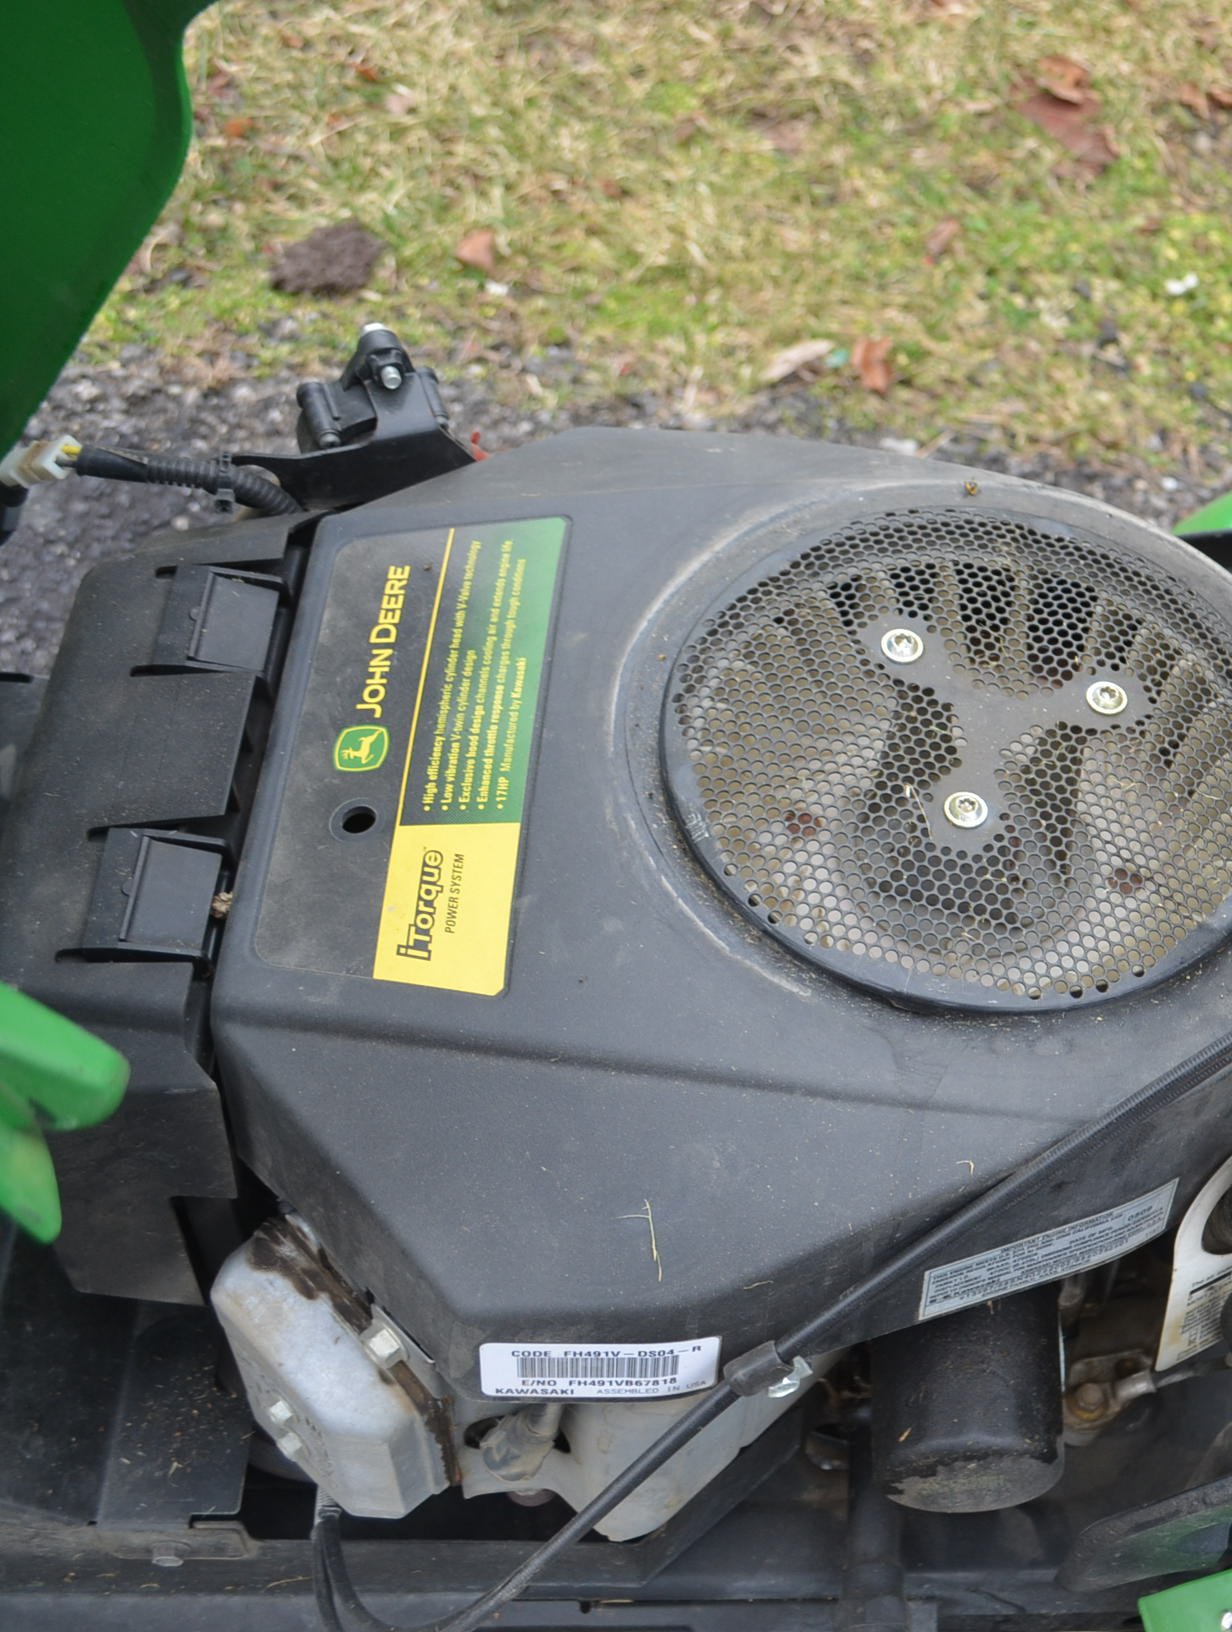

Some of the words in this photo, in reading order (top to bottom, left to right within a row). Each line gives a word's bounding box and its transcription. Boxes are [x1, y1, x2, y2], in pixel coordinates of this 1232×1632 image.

[464, 541, 480, 579] technology
[499, 553, 510, 576] engine
[493, 578, 505, 606] extends
[512, 559, 525, 595] conditions
[369, 565, 410, 643] DEERE
[455, 610, 465, 626] with
[490, 608, 500, 622] and
[507, 597, 520, 618] tough
[450, 628, 462, 648] head
[488, 624, 496, 634] air
[501, 620, 516, 649] through
[445, 650, 458, 681] cylinder
[462, 650, 476, 676] design
[483, 636, 497, 664] cooling
[496, 651, 510, 682] charges
[511, 658, 526, 698] Kawasaki
[356, 649, 393, 718] JOHN
[457, 679, 470, 711] cylinder
[476, 667, 489, 703] channels
[435, 684, 452, 734] hemispheric
[470, 705, 484, 733] design
[491, 685, 504, 722] response
[510, 700, 522, 709] by
[451, 713, 464, 740] V-twin
[485, 725, 497, 756] throttle
[501, 711, 518, 771] Manufactured
[428, 736, 444, 780] efficiency
[446, 742, 459, 781] vibration
[466, 735, 478, 757] hood
[423, 782, 437, 803] High
[441, 784, 453, 803] Low
[459, 759, 475, 802] Exclusive
[477, 758, 492, 802] Enhanced
[496, 777, 508, 801] 17HP
[450, 853, 464, 894] SYSTEM
[397, 850, 443, 961] iTorque
[445, 897, 459, 934] POWER
[512, 1350, 551, 1358] CODE
